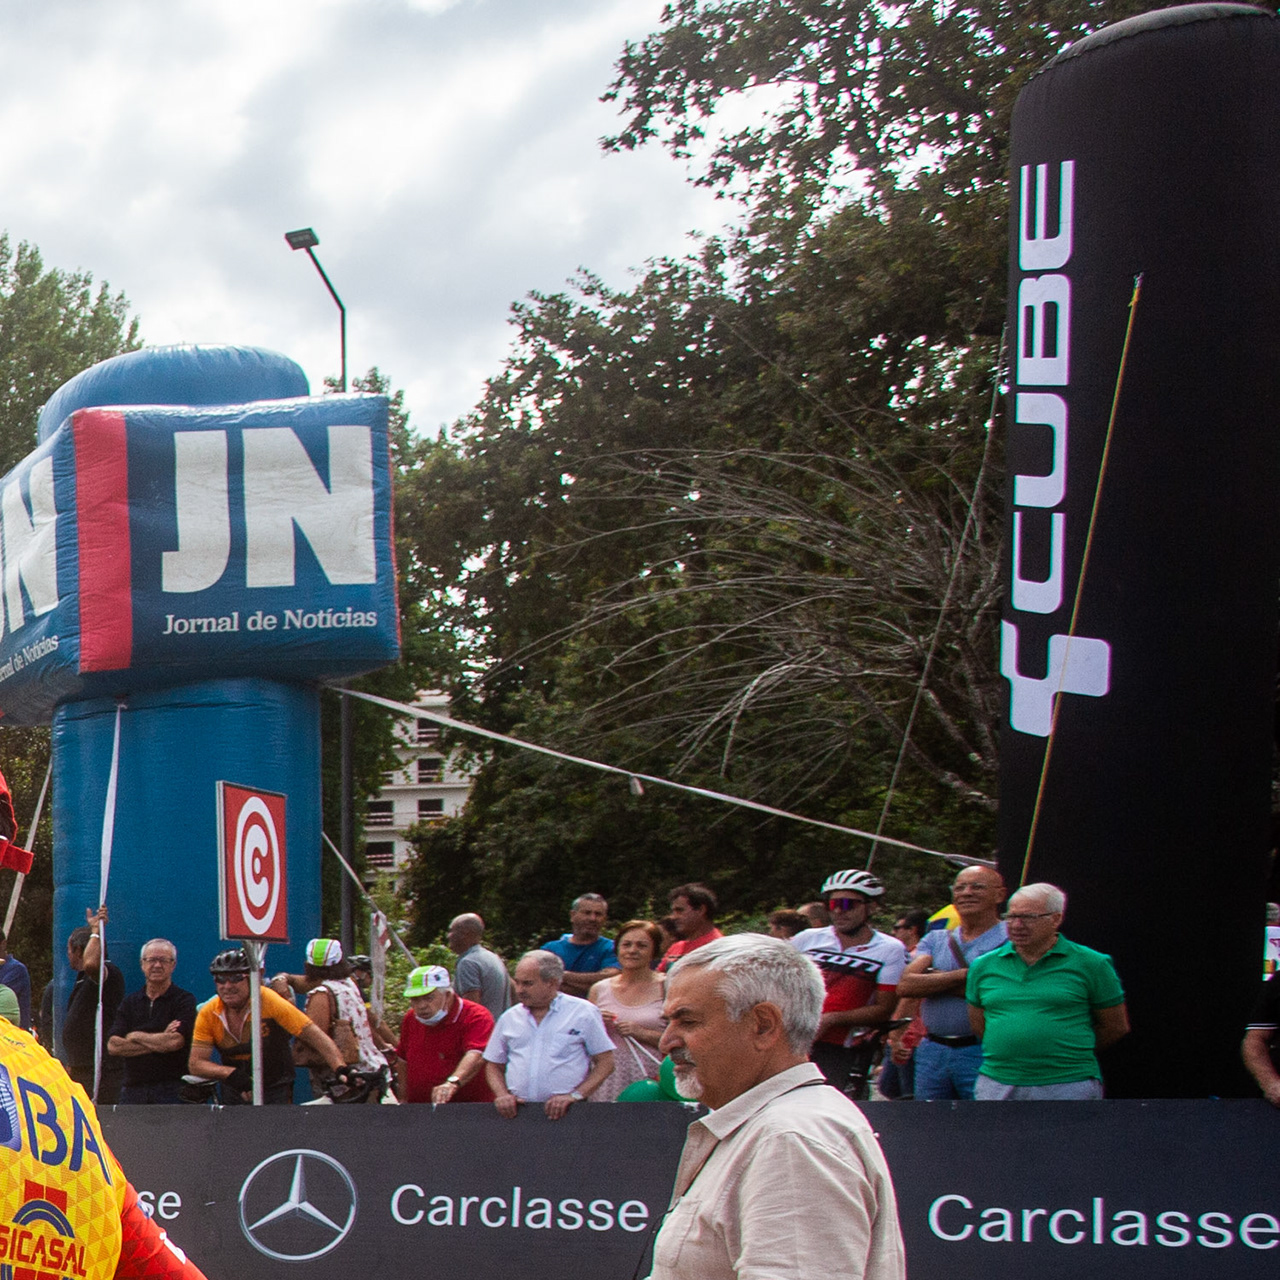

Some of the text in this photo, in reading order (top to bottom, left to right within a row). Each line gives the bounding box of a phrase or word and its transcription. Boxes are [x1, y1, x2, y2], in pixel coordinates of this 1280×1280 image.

[1011, 159, 1075, 614] CUBE
[162, 424, 378, 593] JN
[163, 605, 378, 636] Jornal de Notícias
[390, 1183, 650, 1233] Carclasse
[927, 1194, 1280, 1250] Carclasse
